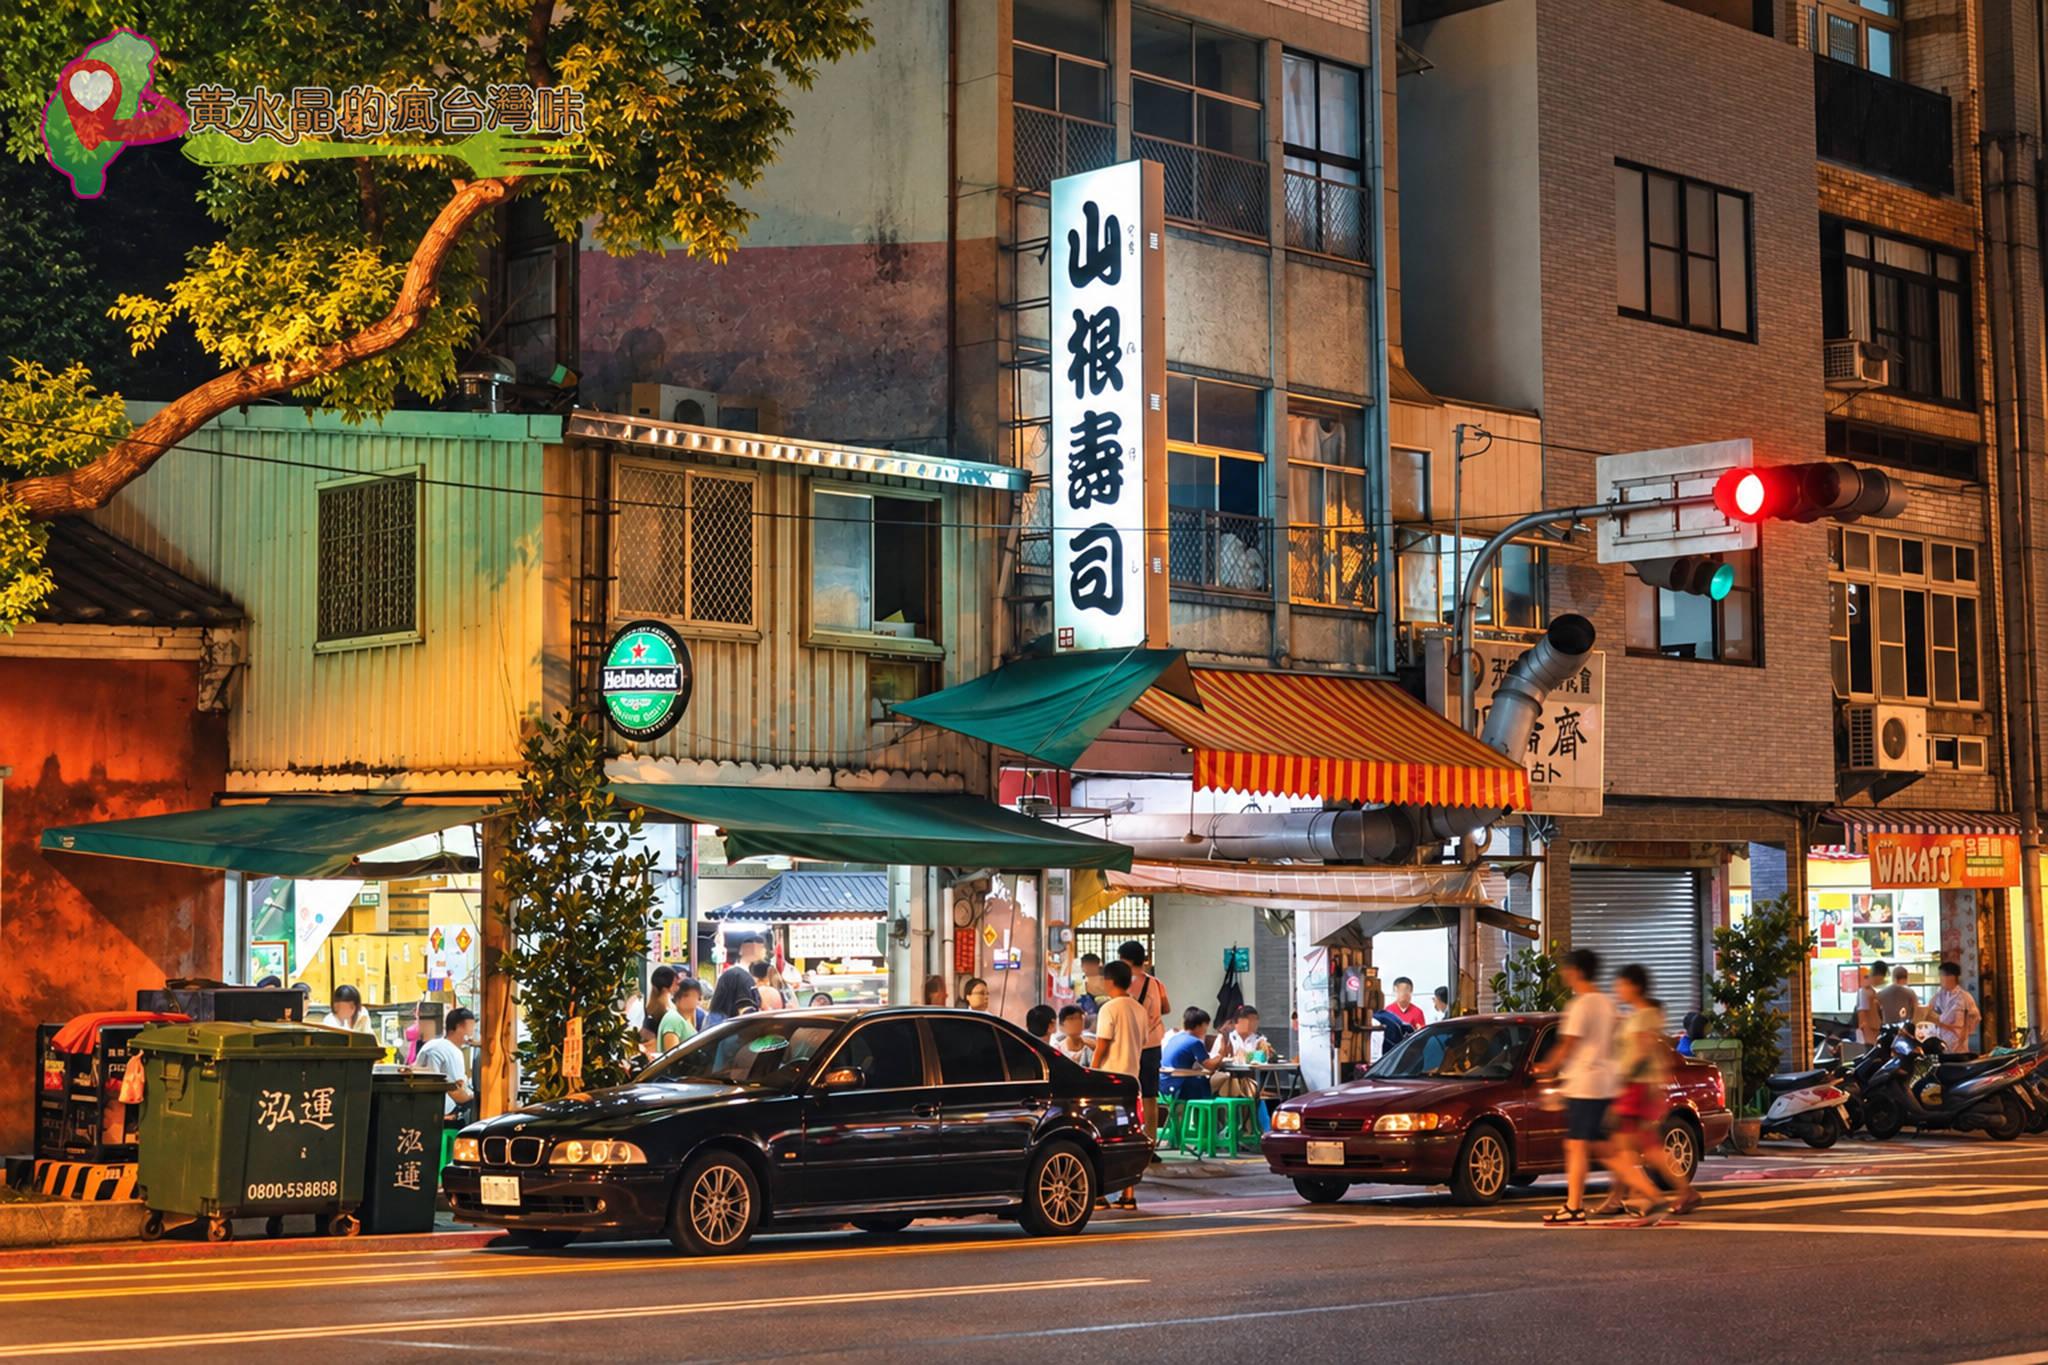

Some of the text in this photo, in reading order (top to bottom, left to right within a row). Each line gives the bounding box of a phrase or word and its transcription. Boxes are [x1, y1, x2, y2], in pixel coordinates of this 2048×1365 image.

[1068, 200, 1123, 616] 山根壽司
[603, 669, 678, 689] Heineken
[257, 1086, 336, 1132] 泓運
